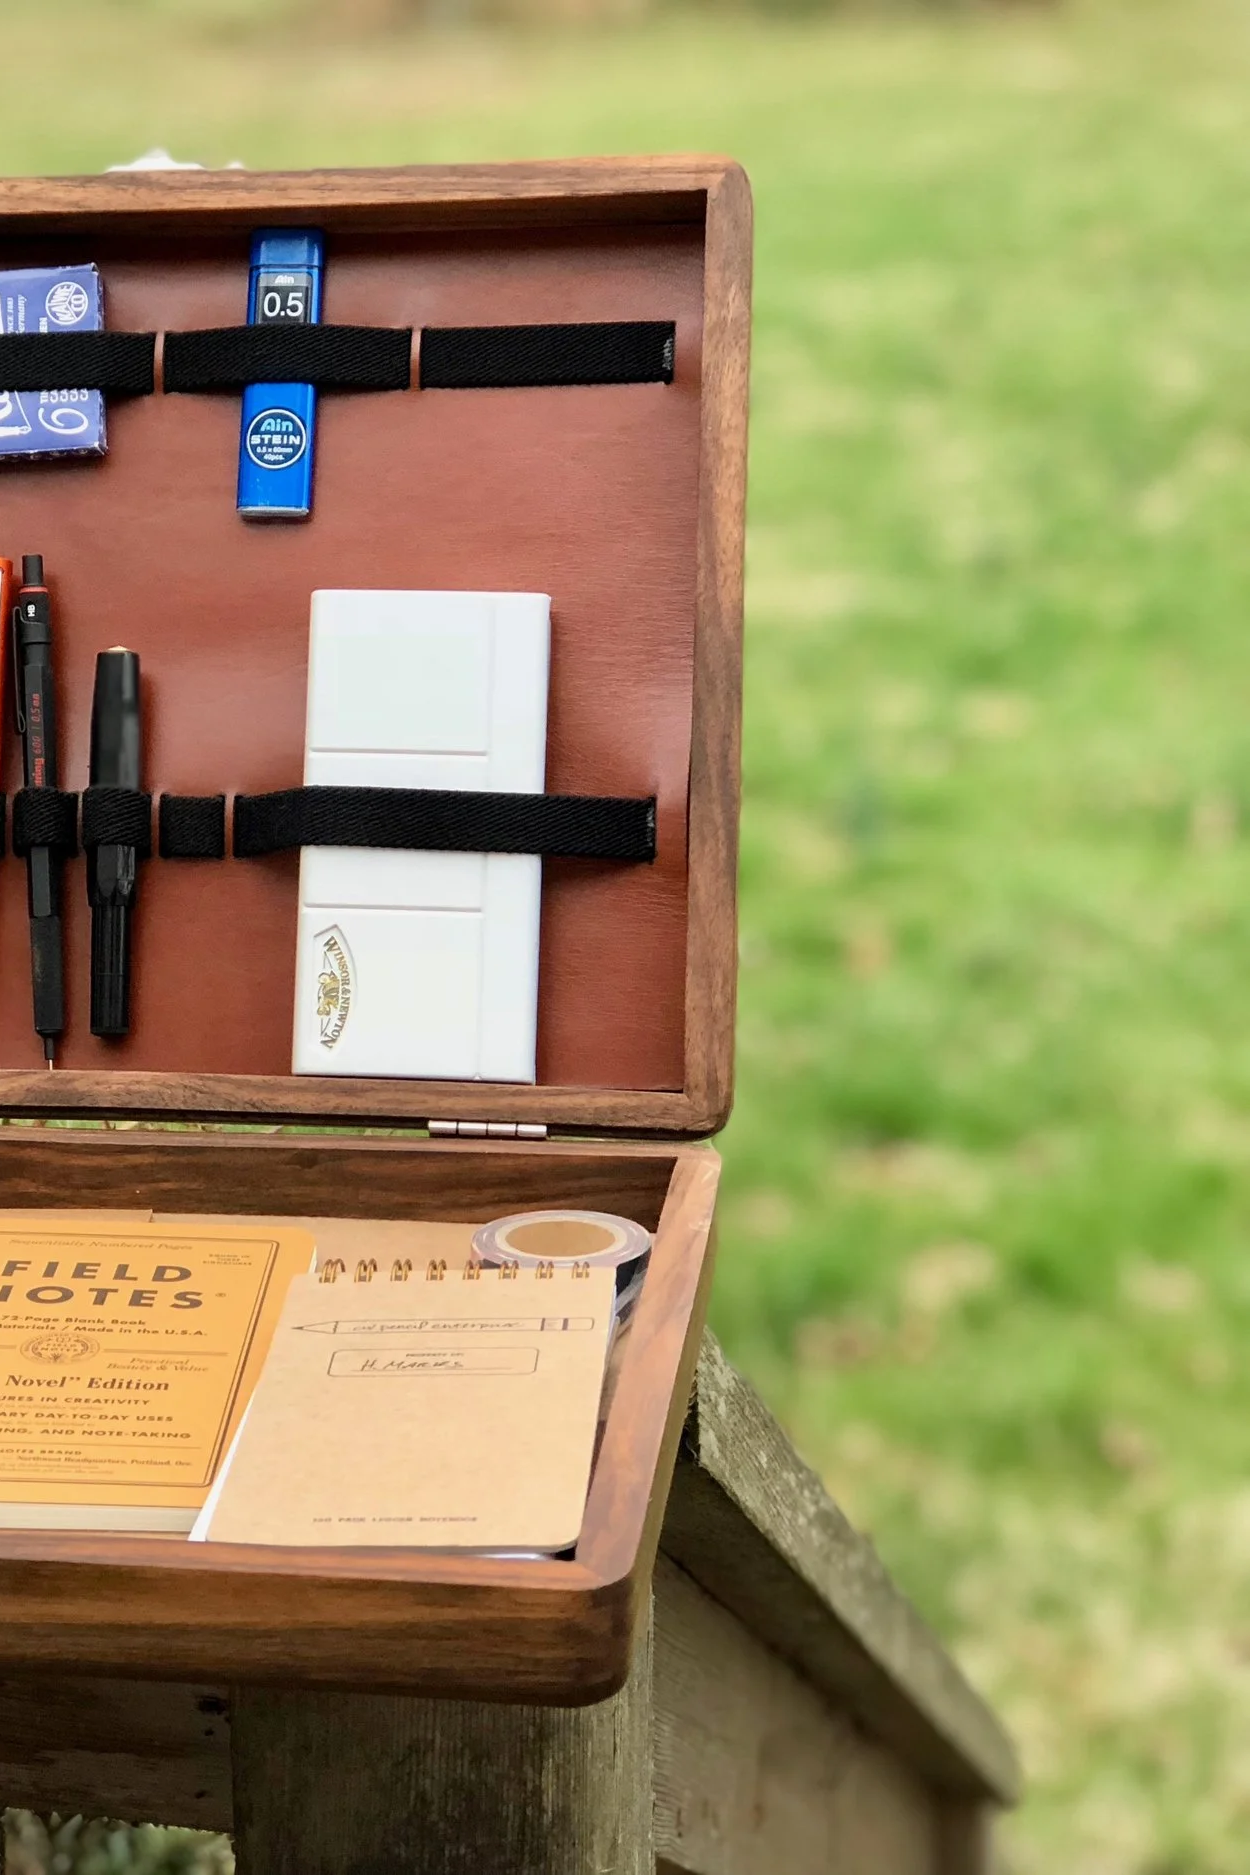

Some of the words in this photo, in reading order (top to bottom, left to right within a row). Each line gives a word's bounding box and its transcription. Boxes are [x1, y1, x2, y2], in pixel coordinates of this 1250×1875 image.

[263, 291, 304, 317] 0.5
[37, 407, 89, 435] 6
[260, 418, 293, 432] Ain
[250, 434, 300, 445] STEIN
[27, 604, 36, 617] HB
[323, 936, 351, 987] WINSOR
[320, 996, 351, 1049] NEWTON
[88, 1241, 152, 1249] Numbered
[157, 1242, 193, 1250] Pages
[1, 1260, 192, 1283] FIELD
[1, 1315, 59, 1323] 72-Page
[106, 1363, 151, 1371] Beauty
[130, 1357, 189, 1365] Practical
[87, 1376, 170, 1391] Edition
[64, 1397, 150, 1405] CREATIVITY
[34, 1412, 130, 1421] DAY-TO-DAY
[40, 1428, 75, 1436] AND
[81, 1430, 192, 1439] NOTE-TAKING
